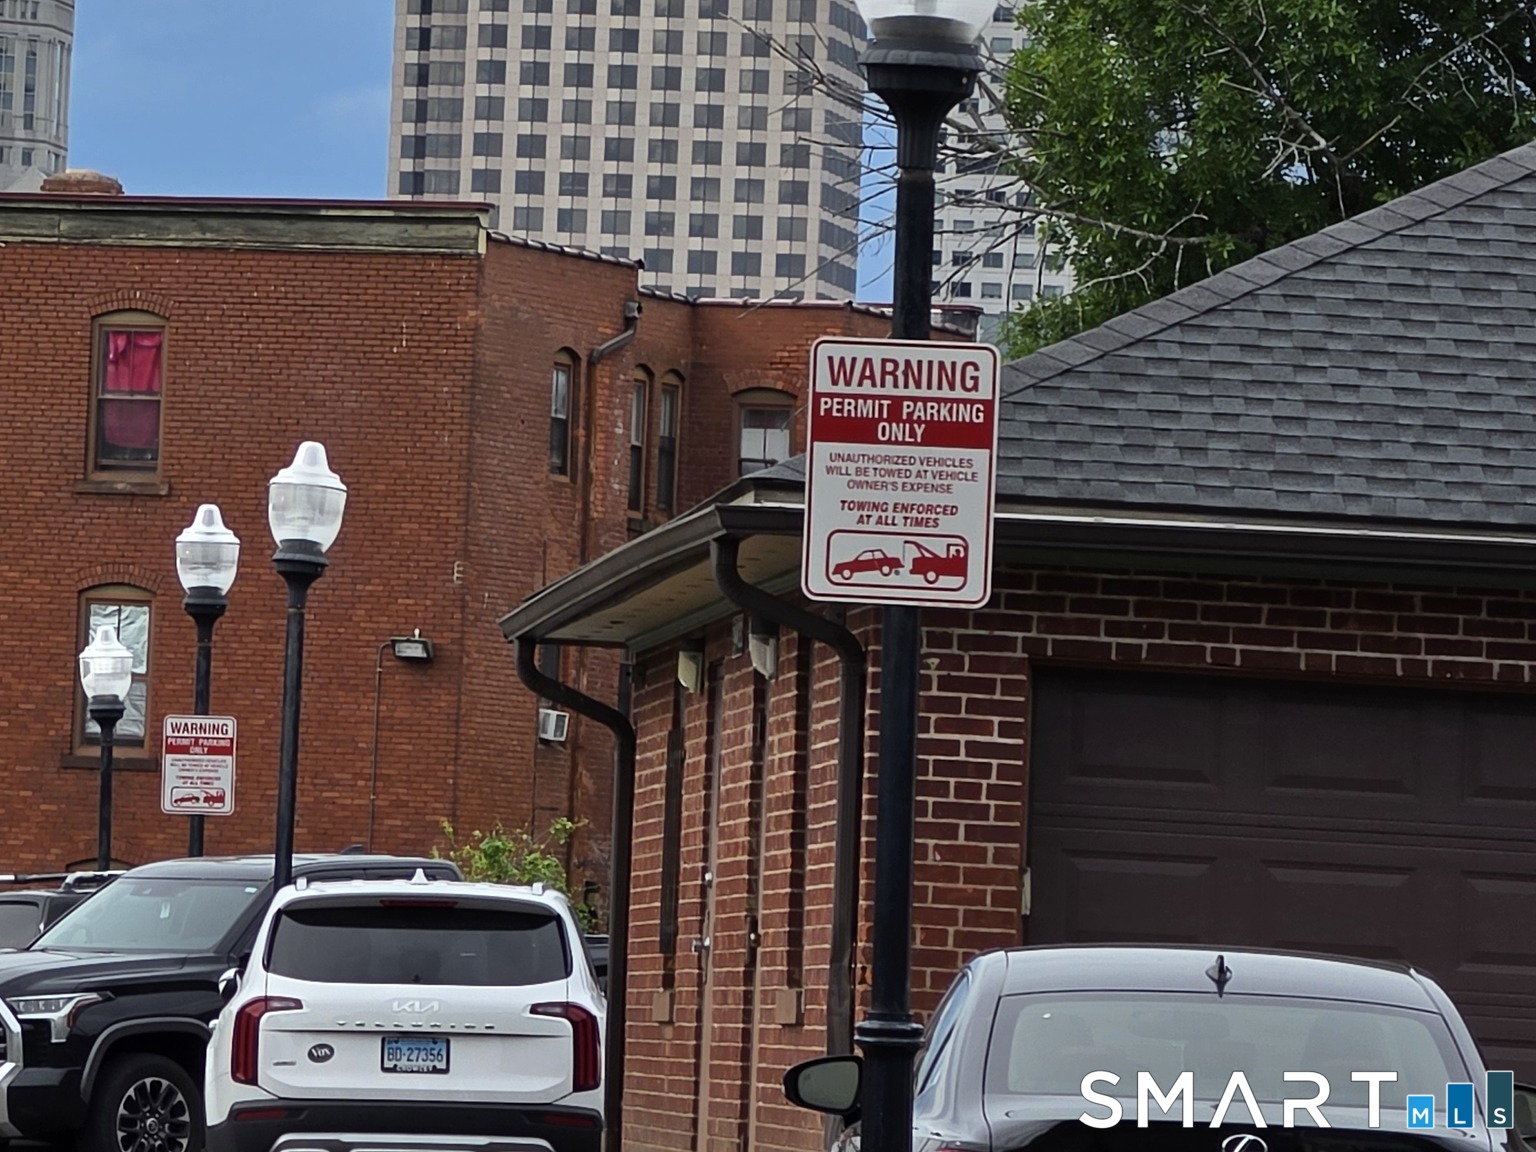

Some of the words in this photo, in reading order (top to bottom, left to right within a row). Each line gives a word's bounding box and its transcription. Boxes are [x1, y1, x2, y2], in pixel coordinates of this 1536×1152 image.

[827, 355, 981, 393] WARNING
[820, 397, 891, 419] PERMIT
[902, 400, 984, 423] PARKING
[877, 422, 926, 443] ONLY
[829, 452, 916, 466] UNAUTHORIZED
[919, 456, 974, 469] VEHICLES
[826, 465, 851, 476] WILL
[855, 466, 870, 477] BE
[872, 468, 912, 479] TOWED
[915, 469, 929, 480] AT
[931, 470, 979, 482] VEHICLE
[847, 479, 899, 491] OWNER'S
[901, 482, 954, 494] EXPENSE
[840, 500, 888, 513] TOWING
[892, 502, 959, 516] ENFORCED
[856, 514, 873, 525] AT
[875, 515, 898, 527] ALL
[902, 516, 940, 528] TIMES
[170, 722, 229, 735] WARNING
[392, 1000, 440, 1013] KIA
